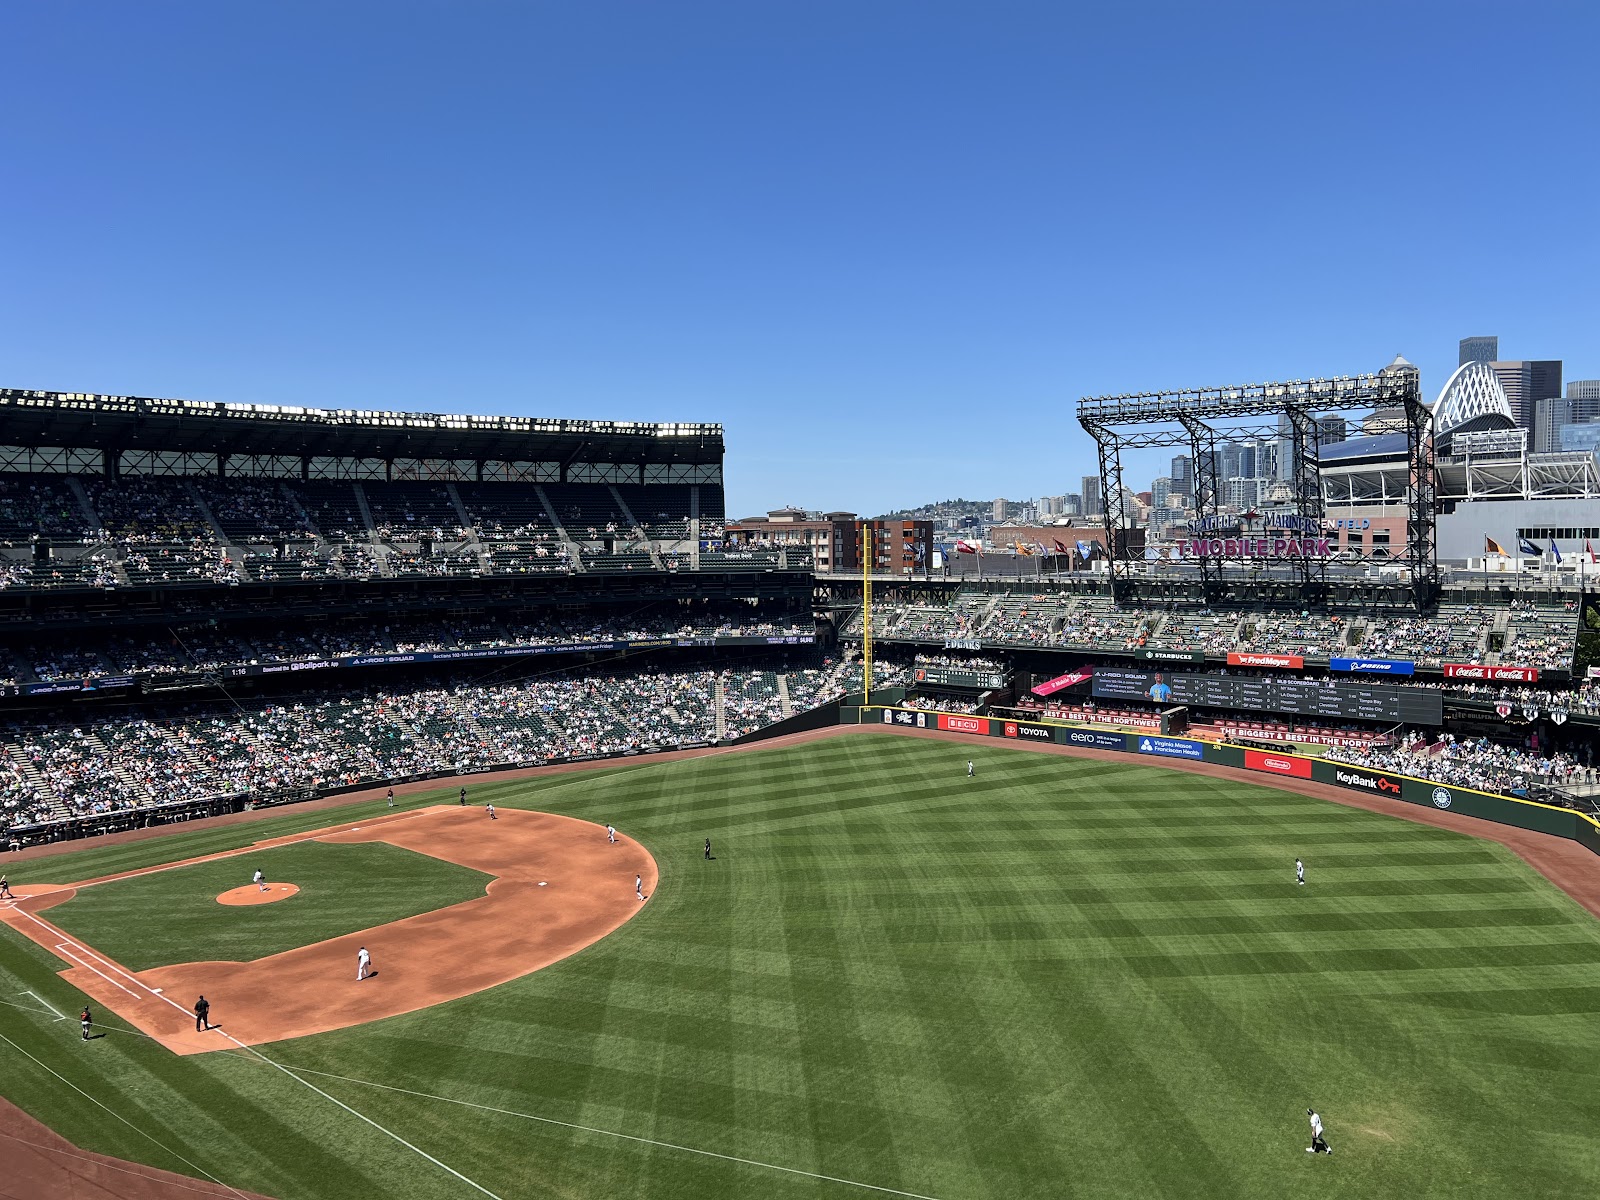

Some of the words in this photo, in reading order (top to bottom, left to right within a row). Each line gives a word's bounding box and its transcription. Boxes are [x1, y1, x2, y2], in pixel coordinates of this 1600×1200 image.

[1187, 513, 1237, 534] SEATTLE
[1263, 510, 1319, 536] MARINERS
[1337, 518, 1370, 529] FIELD
[1176, 538, 1269, 557] T-MOBILE
[1274, 538, 1333, 557] PARK
[299, 661, 330, 671] Ballpark
[360, 657, 384, 665] J-ROD
[231, 667, 247, 676] 1:16
[1287, 679, 1320, 687] SCOREBOARD
[950, 719, 977, 730] BECU
[1061, 711, 1067, 719] &
[1068, 712, 1086, 720] BEST
[1097, 715, 1112, 723] THE
[1113, 716, 1162, 727] NORTHWEST
[1019, 727, 1049, 738] TOYOTA
[1071, 732, 1095, 743] eero
[1220, 727, 1237, 736] THE
[1238, 729, 1276, 740] BIGGEST
[1276, 733, 1285, 741] &
[1285, 733, 1308, 743] BEST
[1309, 735, 1320, 744] IN
[1321, 737, 1339, 747] THE
[1153, 740, 1174, 748] Virginia
[1154, 746, 1182, 755] Franciscan
[1182, 748, 1200, 757] Health
[533, 759, 548, 767] Clips
[465, 766, 491, 774] LEXUS
[1336, 770, 1377, 790] KeyBank
